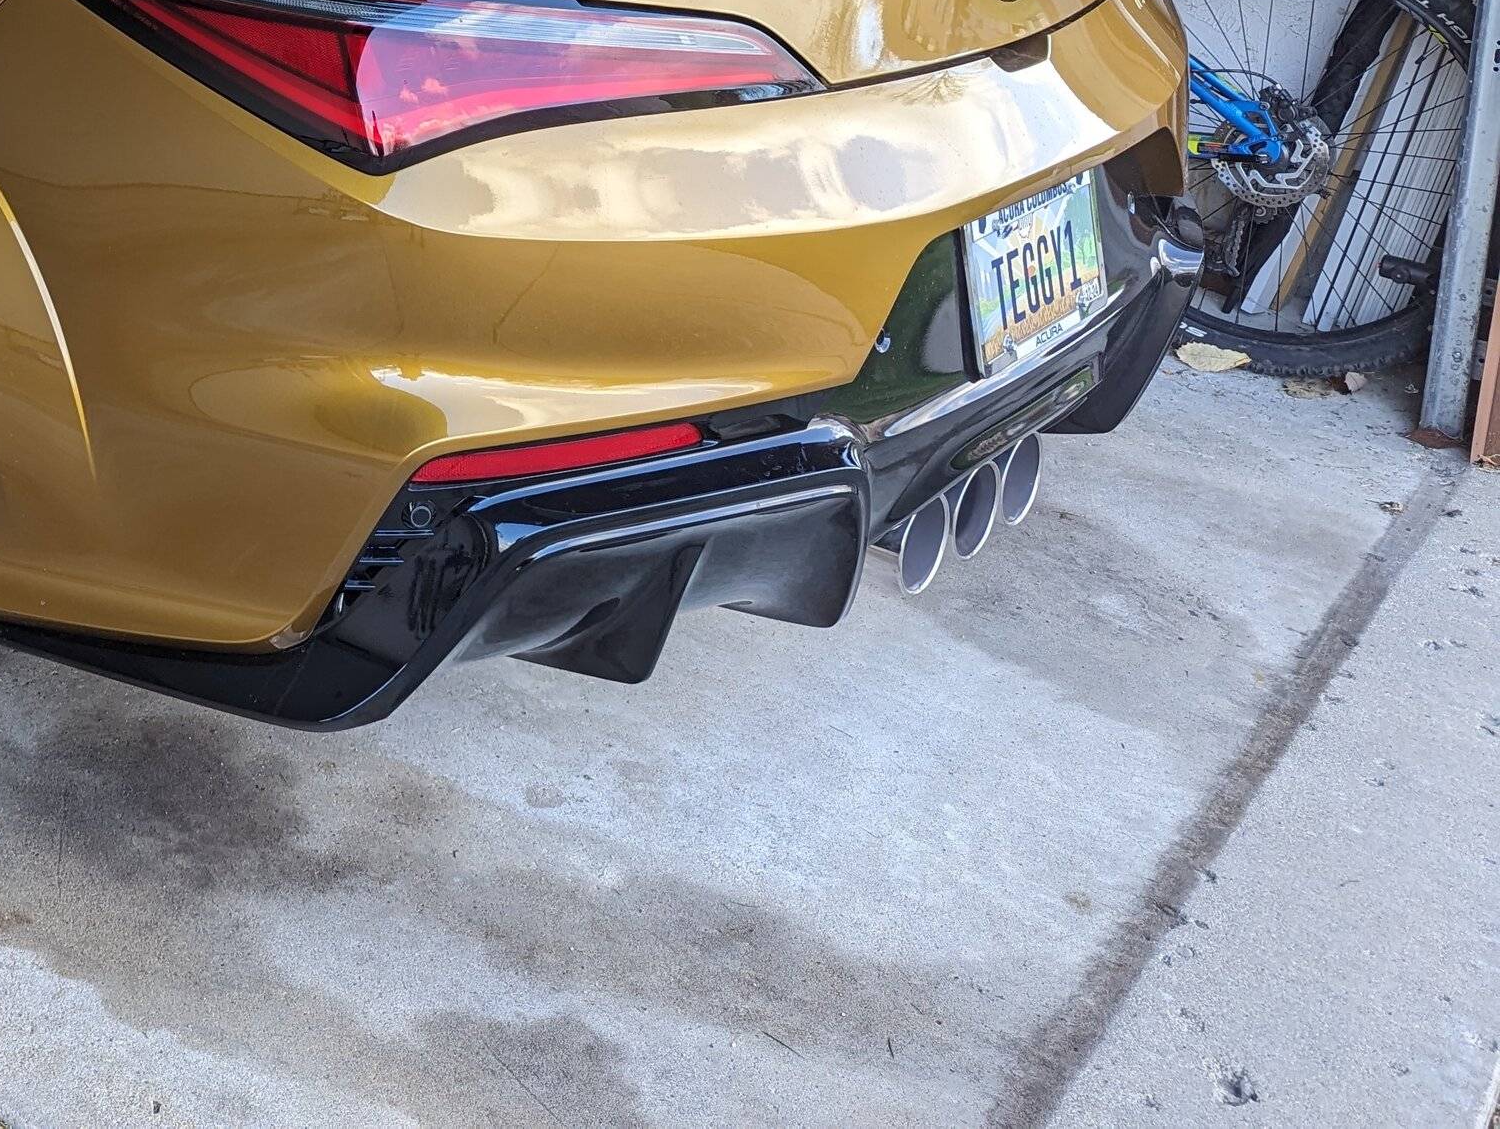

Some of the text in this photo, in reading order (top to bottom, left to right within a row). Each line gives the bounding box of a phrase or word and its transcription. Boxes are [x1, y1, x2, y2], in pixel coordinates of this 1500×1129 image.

[998, 202, 1025, 224] ACURA
[991, 220, 1082, 330] TEGGY1
[1035, 322, 1064, 348] ACURA
